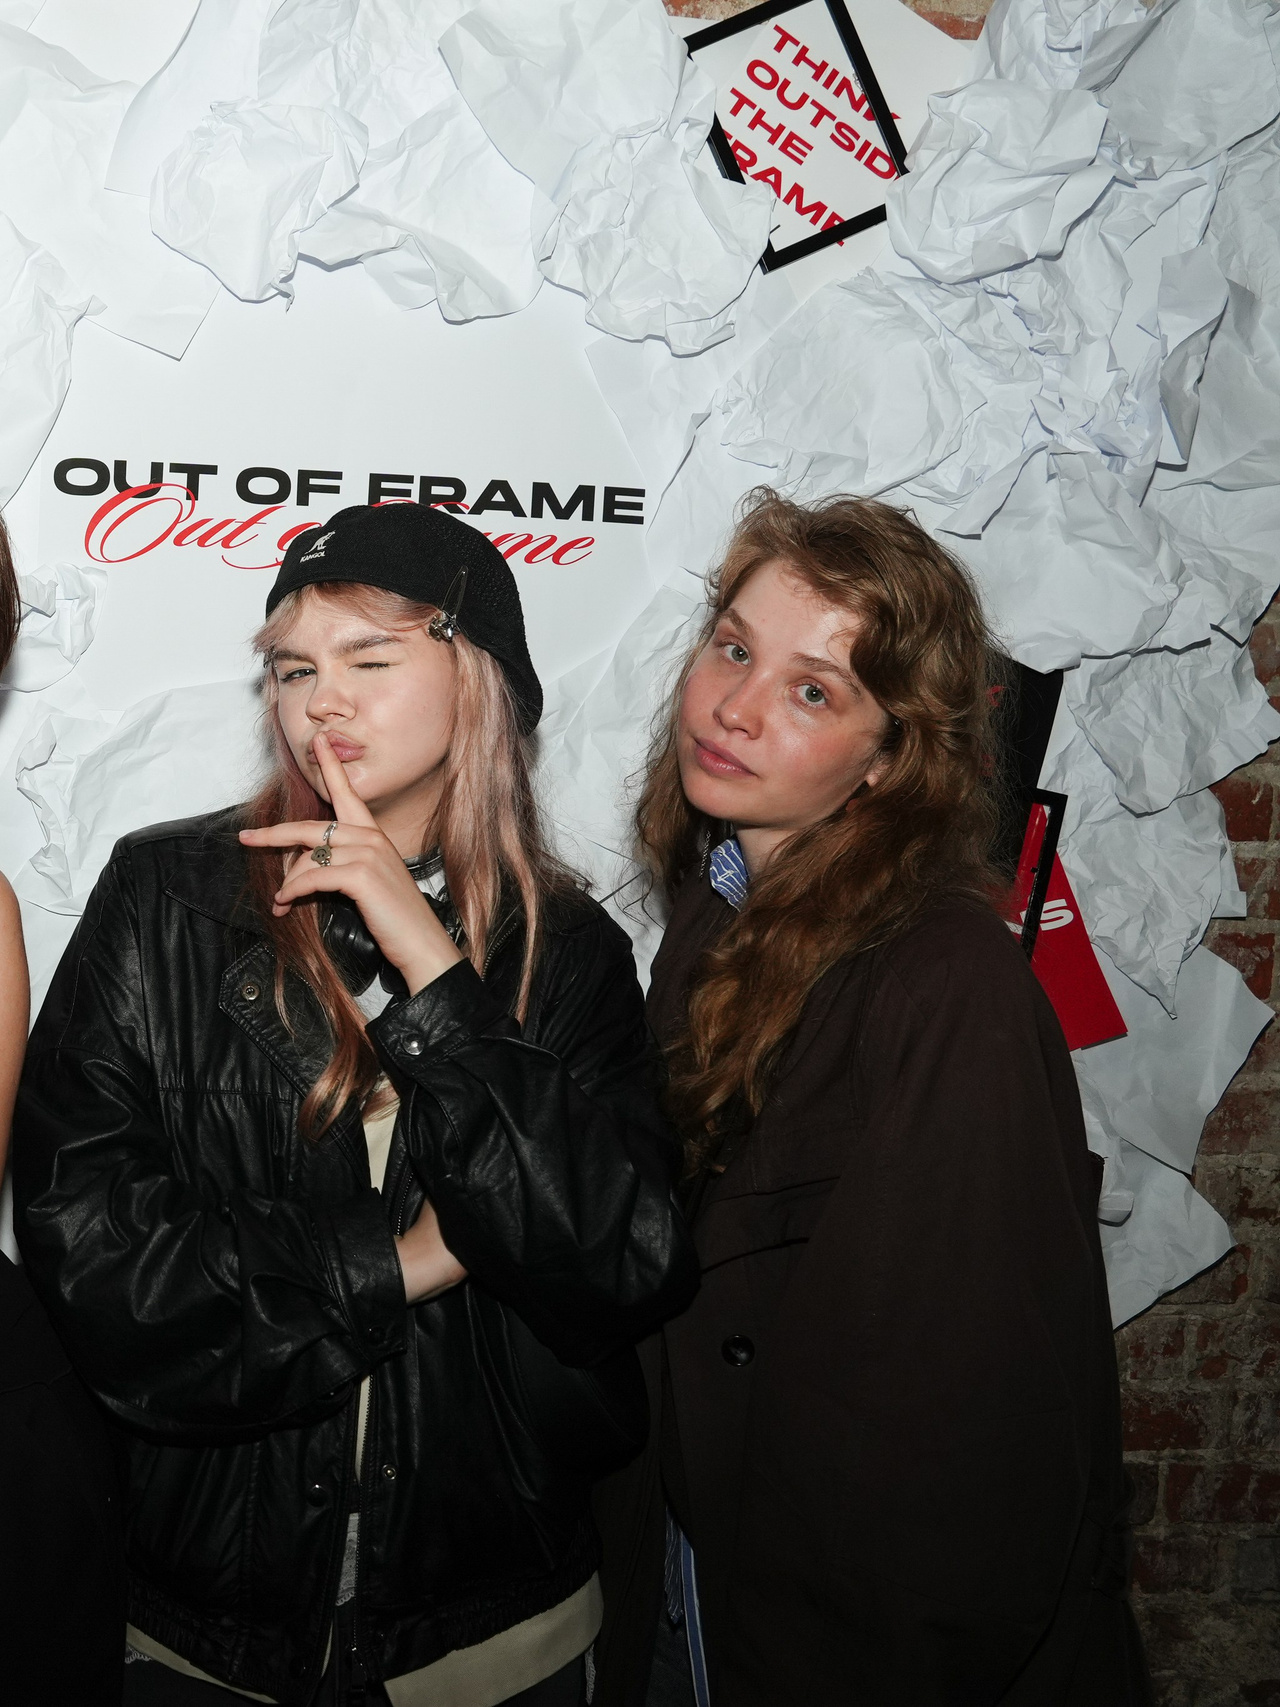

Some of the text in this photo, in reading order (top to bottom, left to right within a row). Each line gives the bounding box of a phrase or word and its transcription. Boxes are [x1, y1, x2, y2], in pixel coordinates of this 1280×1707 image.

[729, 87, 815, 166] THE
[746, 59, 900, 181] OUTSID
[722, 129, 845, 247] RAM
[53, 457, 646, 525] OUT OF FRAME
[84, 482, 287, 563] Out
[299, 550, 326, 563] KANGOL
